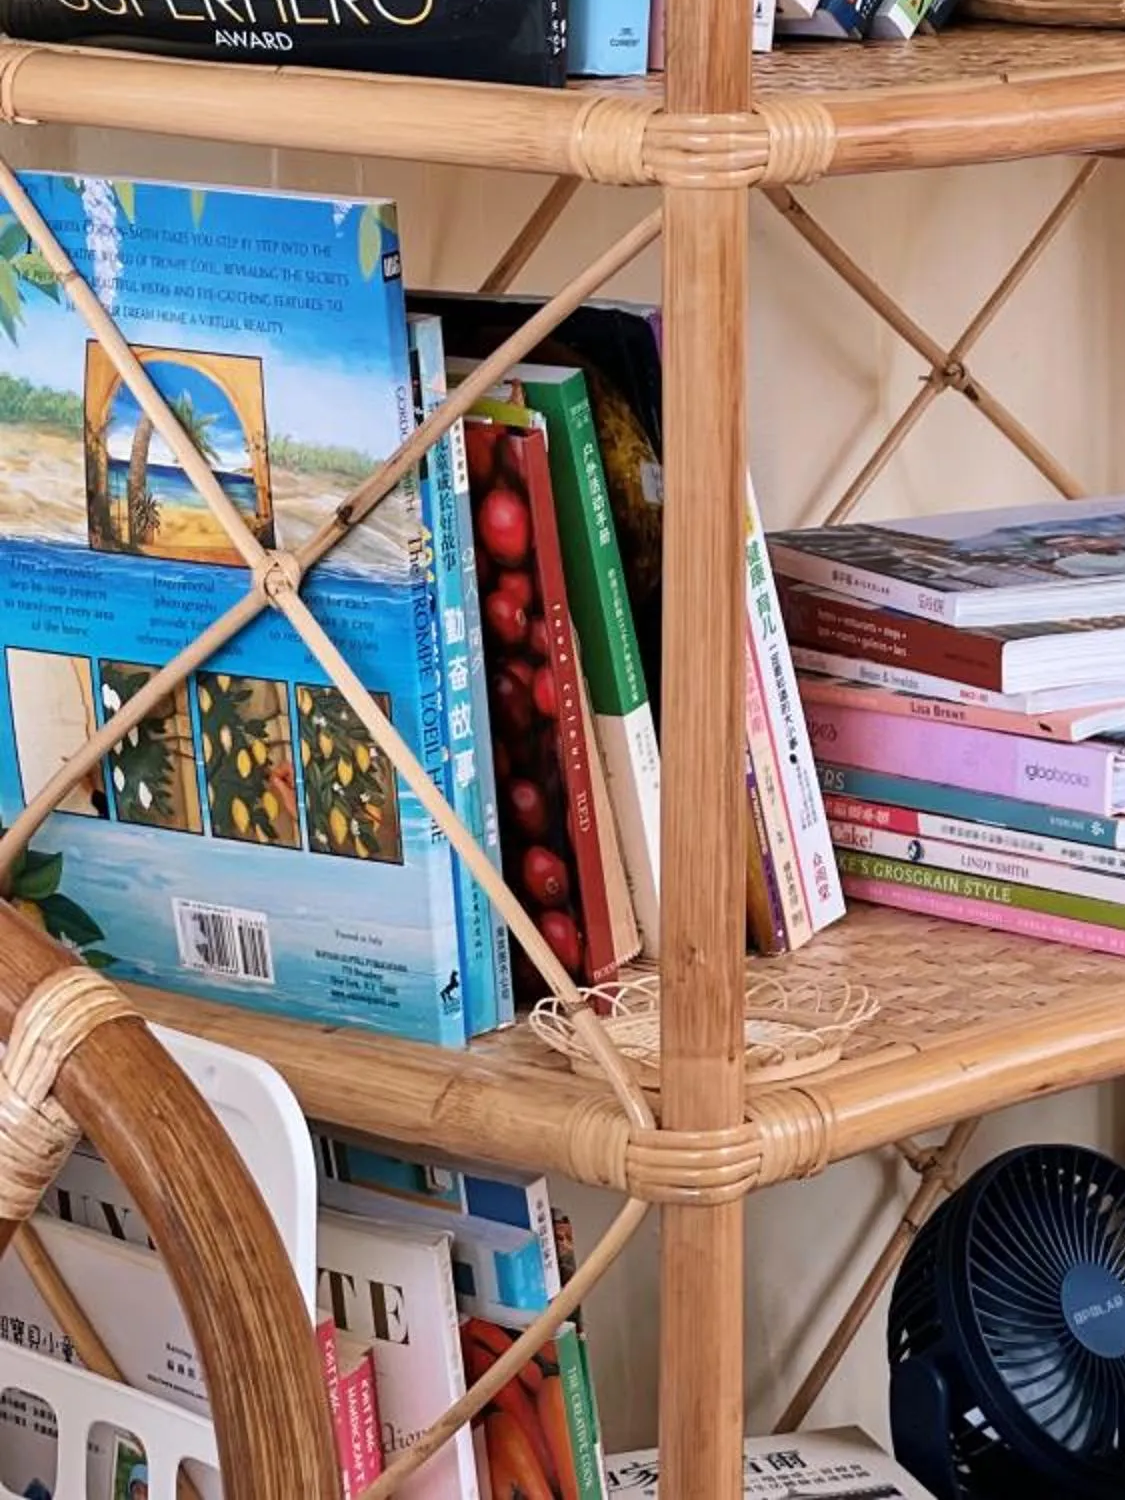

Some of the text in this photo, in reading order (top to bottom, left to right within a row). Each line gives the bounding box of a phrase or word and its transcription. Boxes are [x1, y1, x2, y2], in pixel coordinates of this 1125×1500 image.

[214, 29, 294, 52] AWARD
[408, 536, 421, 576] The
[411, 578, 432, 678] TROMPE
[421, 692, 435, 762] L'OEIL
[909, 701, 931, 717] Lisa
[1025, 763, 1090, 788] igloobooks
[577, 791, 590, 834] RED
[830, 823, 874, 850] Cake!
[873, 861, 960, 894] GROSGRAIN
[962, 880, 1012, 903] STYLE
[960, 853, 1030, 879] LINDY SMITH
[571, 1393, 586, 1454] CREATIVE
